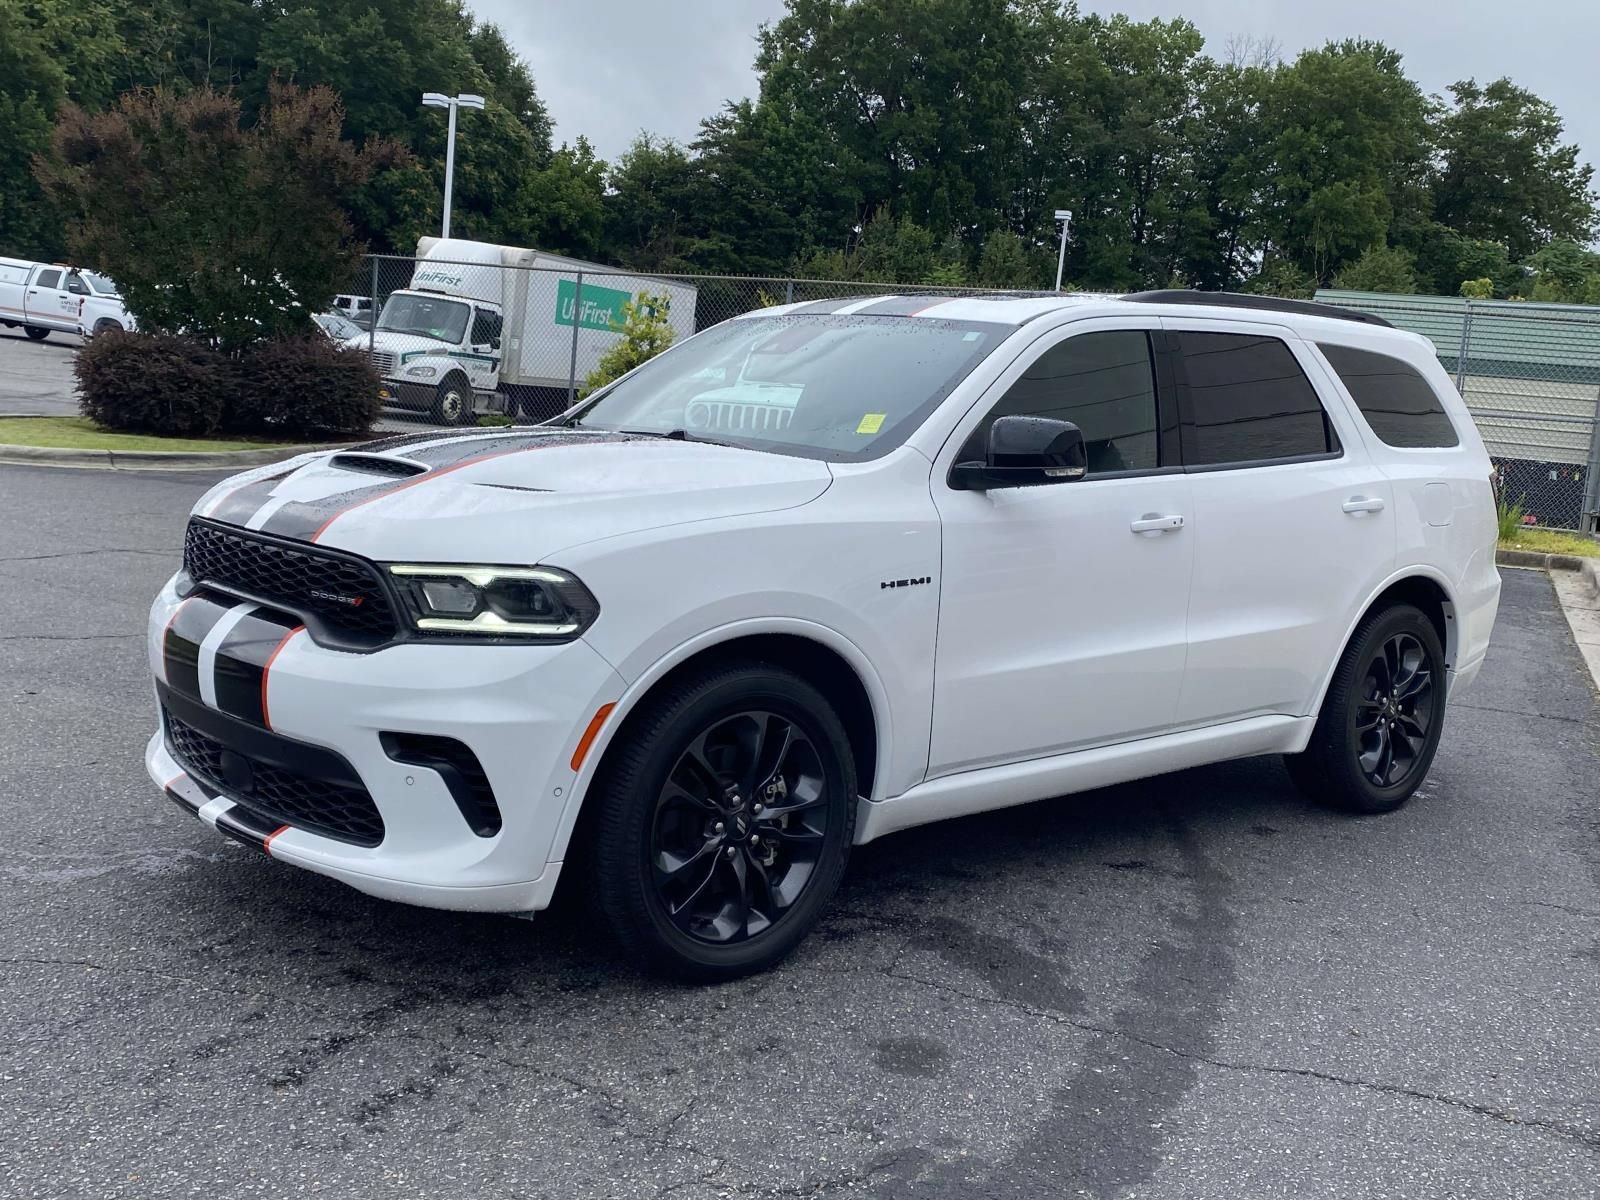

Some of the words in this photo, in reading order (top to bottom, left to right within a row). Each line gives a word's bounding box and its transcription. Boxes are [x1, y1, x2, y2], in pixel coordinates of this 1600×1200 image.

[415, 271, 461, 286] UniFirst
[881, 576, 931, 589] HEMI
[311, 590, 355, 604] DODGE
